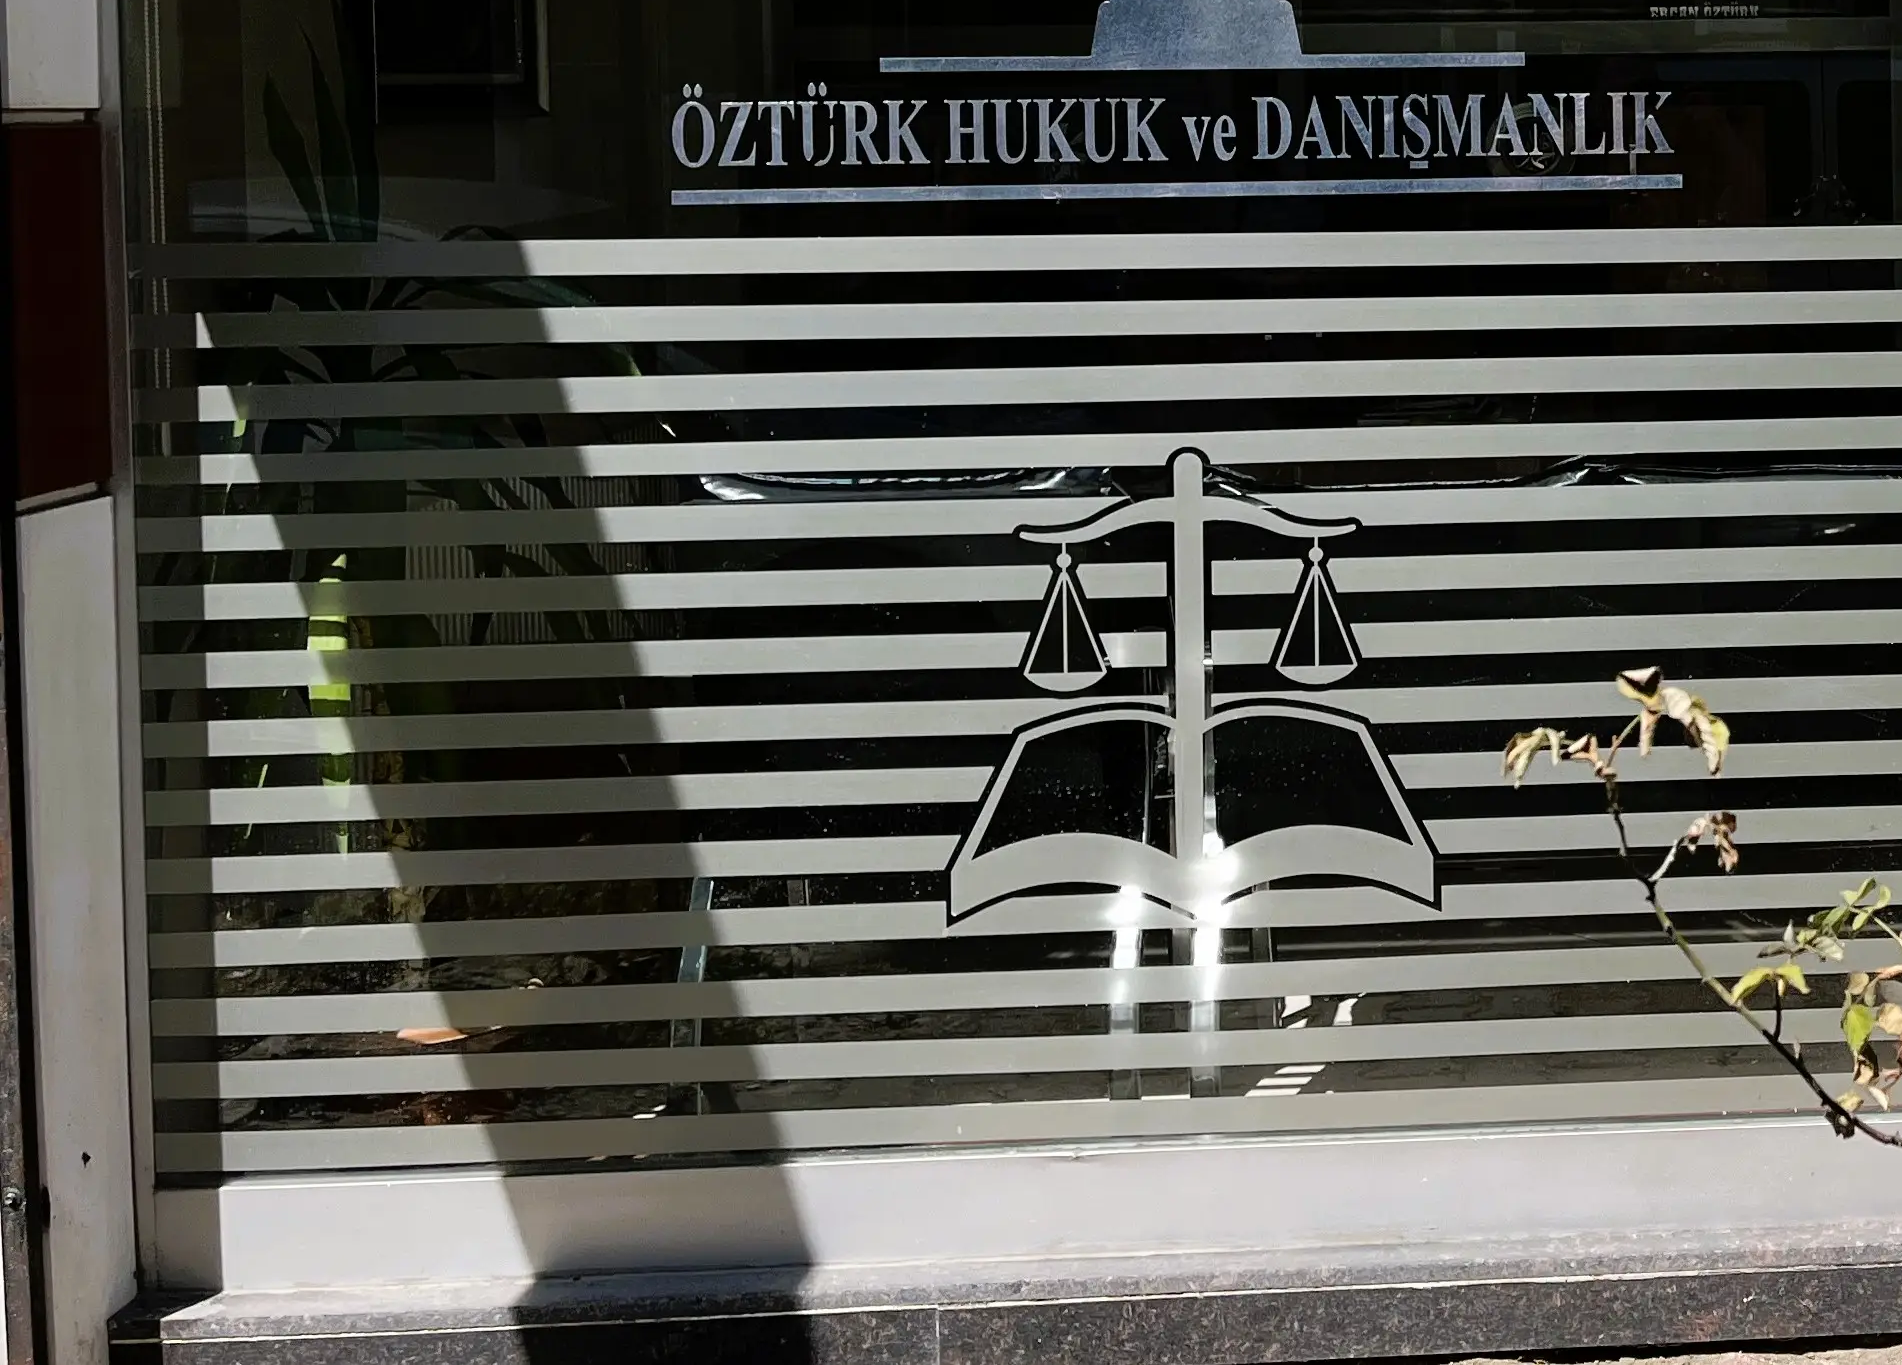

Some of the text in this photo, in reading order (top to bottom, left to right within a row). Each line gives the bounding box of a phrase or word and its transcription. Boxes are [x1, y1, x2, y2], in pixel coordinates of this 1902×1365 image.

[671, 82, 1675, 169] ÖZTÜRK HUKUK ve DANIŞMANLIK
